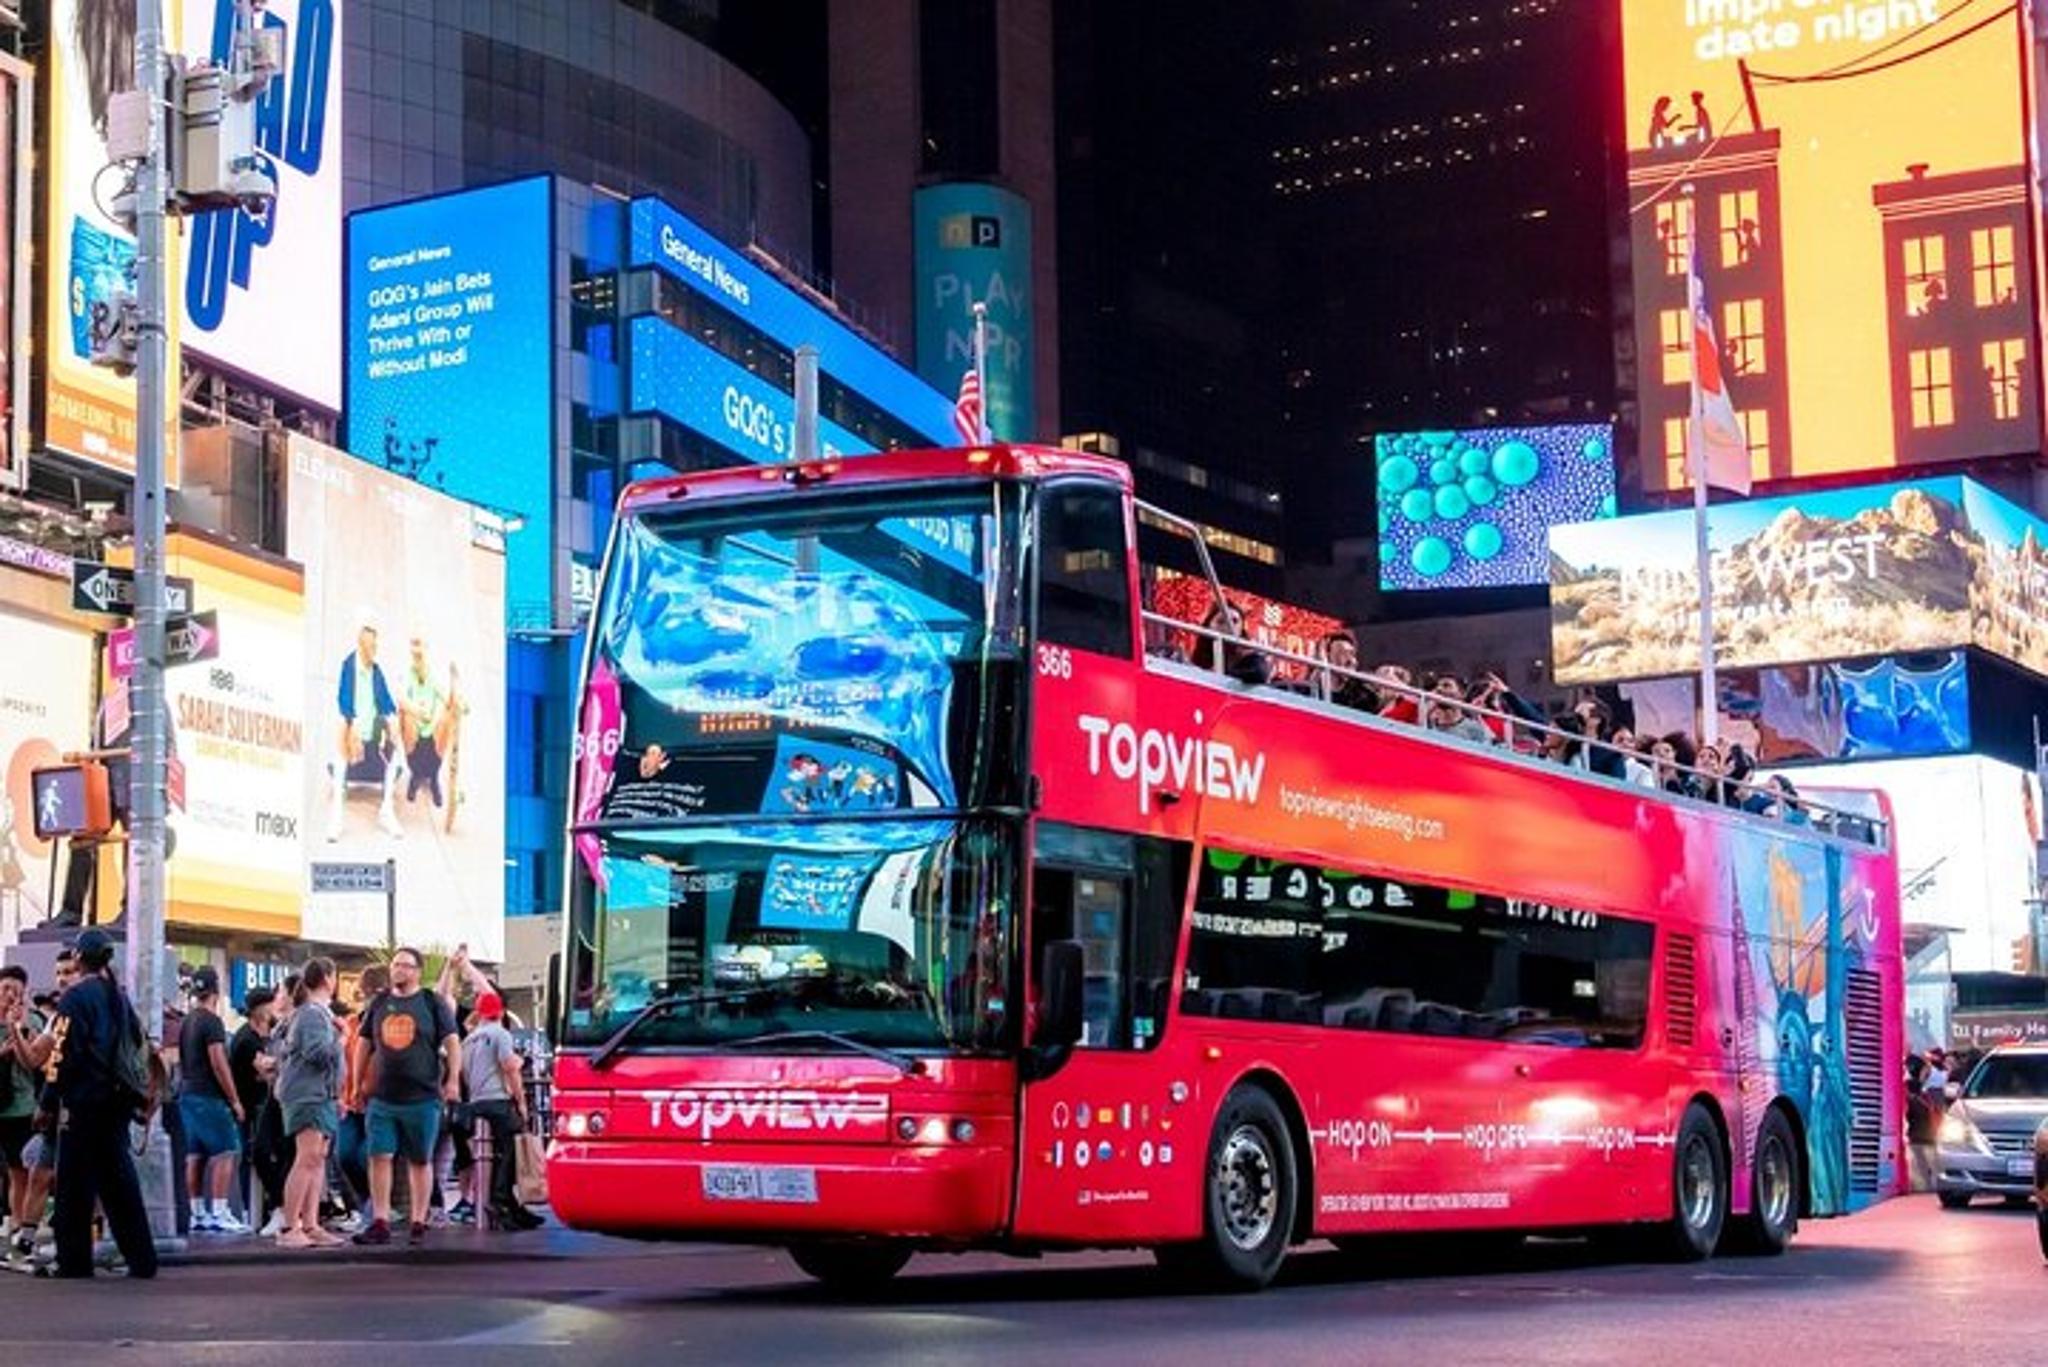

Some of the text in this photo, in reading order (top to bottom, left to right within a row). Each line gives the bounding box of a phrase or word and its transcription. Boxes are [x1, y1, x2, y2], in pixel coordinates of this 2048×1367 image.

[1695, 0, 1938, 60] date night
[368, 245, 452, 272] General News
[660, 224, 750, 305] General News
[422, 279, 454, 299] Jain
[455, 272, 492, 292] Bets
[934, 270, 1026, 320] PLAY
[368, 293, 494, 331] Adani Group Will
[368, 324, 473, 355] Thrive With or
[945, 320, 1023, 374] NPR
[368, 344, 469, 379] Without Modi
[1748, 531, 1887, 590] WEST
[92, 578, 126, 600] ONE
[170, 628, 199, 651] WAY
[1038, 644, 1072, 680] 366
[177, 692, 225, 738] SARAH
[227, 705, 303, 756] SILVERMAN
[255, 810, 298, 840] max
[1328, 1121, 1392, 1163] HOP ON
[1463, 1121, 1495, 1163] HOP
[1586, 1125, 1637, 1163] HOP ON
